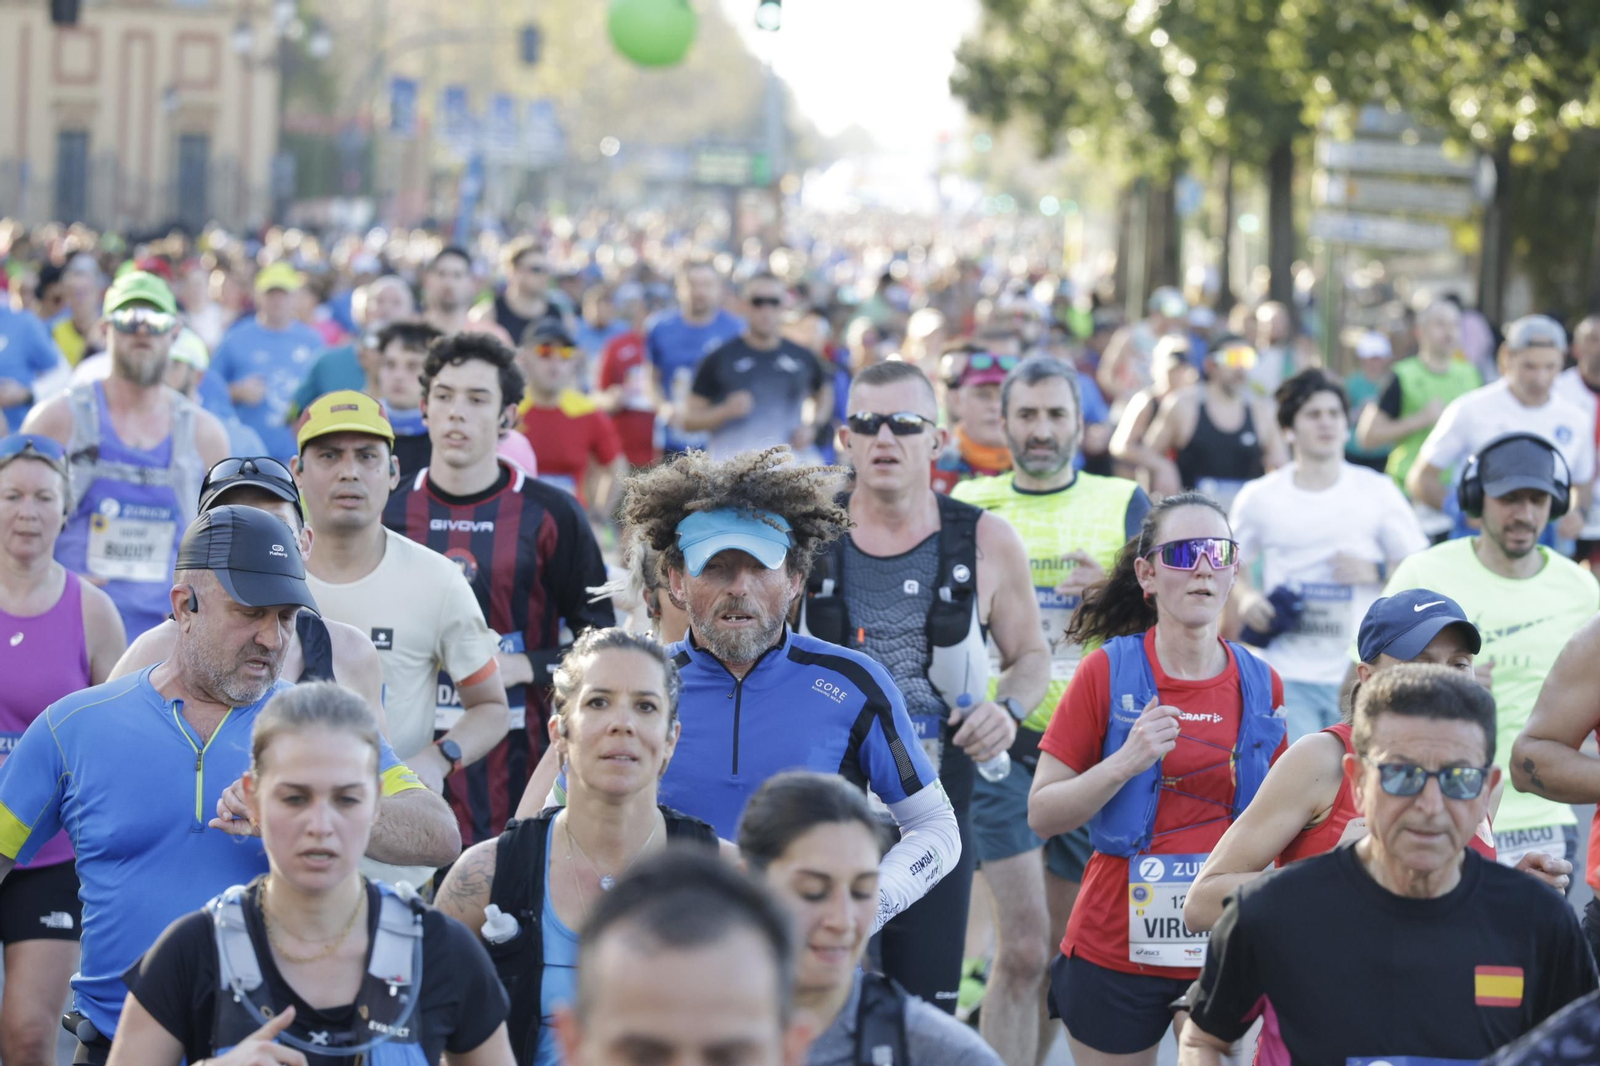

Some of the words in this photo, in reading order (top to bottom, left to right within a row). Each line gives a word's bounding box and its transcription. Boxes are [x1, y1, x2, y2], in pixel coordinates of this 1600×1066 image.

[430, 519, 494, 533] GIVOVA
[815, 678, 848, 701] GORE
[1179, 712, 1212, 722] CRAFT
